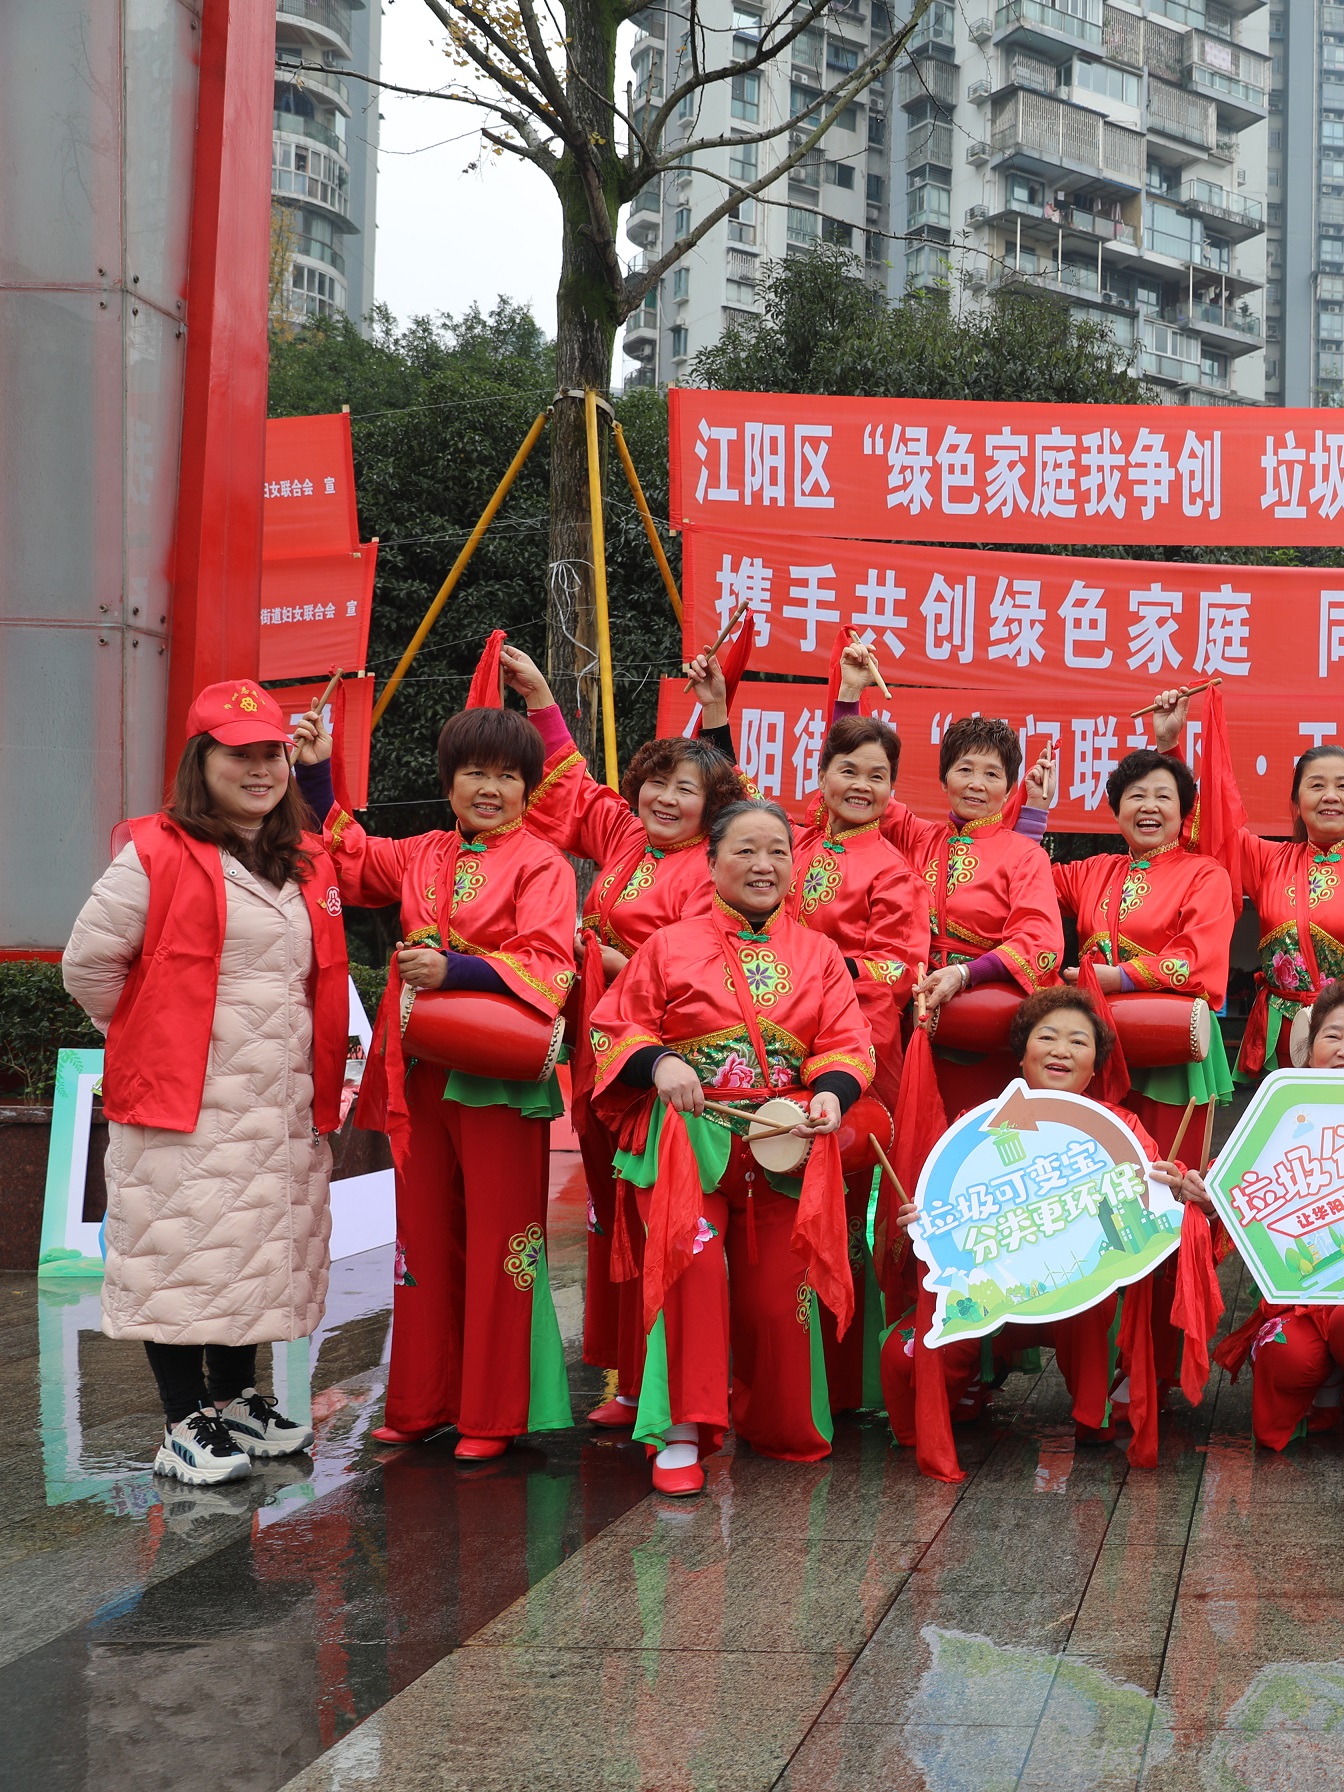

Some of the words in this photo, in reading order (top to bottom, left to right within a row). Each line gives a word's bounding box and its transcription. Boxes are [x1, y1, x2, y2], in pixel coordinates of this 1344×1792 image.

[324, 476, 336, 494] 宣
[260, 602, 336, 625] 街道妇女联合会
[346, 600, 358, 617] 宣
[715, 554, 1253, 676] 携手共创绿色家庭
[919, 1139, 1106, 1240] 垃圾可变宝
[964, 1162, 1145, 1265] 分类更环保
